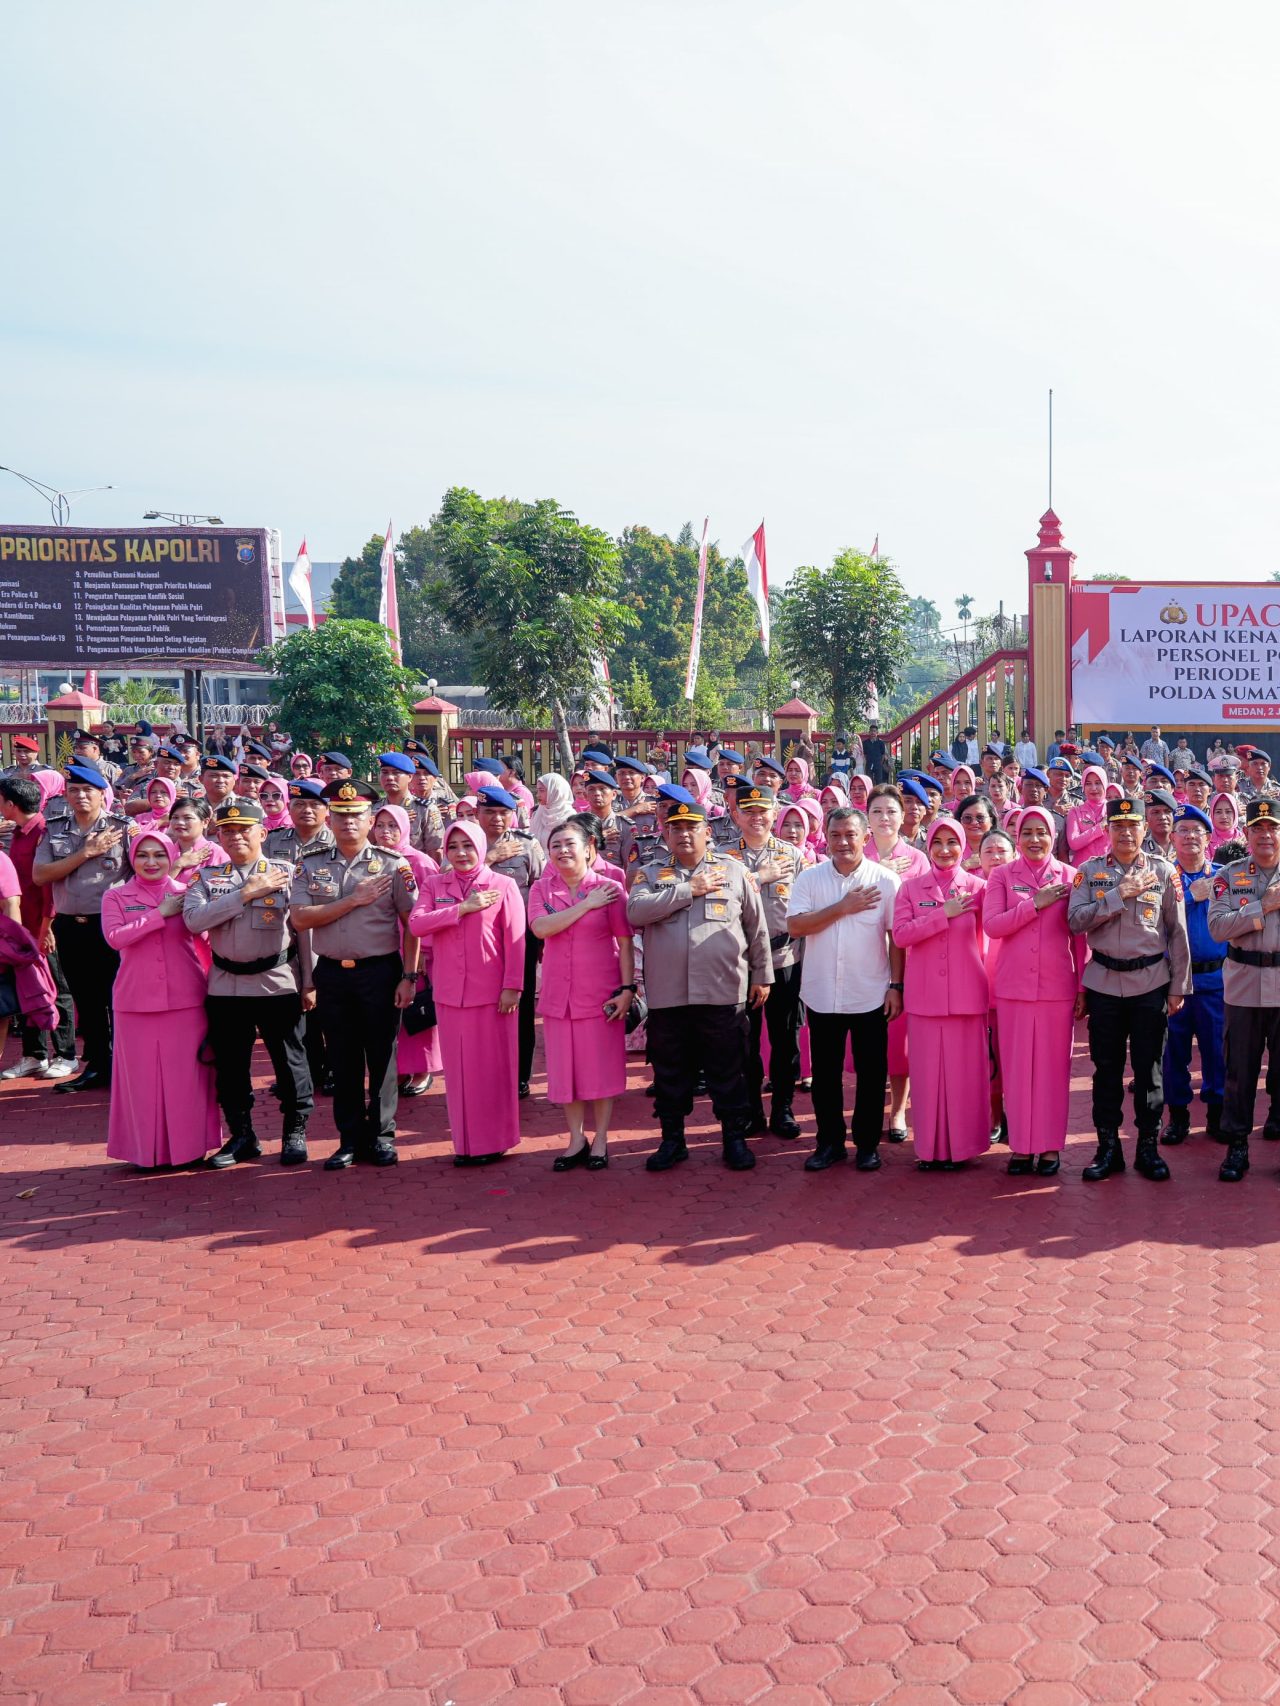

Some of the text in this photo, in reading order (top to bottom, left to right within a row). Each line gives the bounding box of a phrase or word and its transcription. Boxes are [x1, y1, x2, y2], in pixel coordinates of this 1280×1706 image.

[0, 536, 220, 563] PRIORITAS KAPOLRI
[136, 571, 160, 579] Nasional
[73, 581, 82, 589] 10.
[84, 582, 111, 590] Menjamin
[140, 582, 163, 590] Program
[188, 582, 212, 590] Nasional
[29, 591, 39, 599] 4.0
[73, 592, 82, 600] 11.
[84, 592, 114, 601] Penguatan
[114, 593, 147, 601] Penanganan
[85, 603, 119, 611] Peningkatan
[142, 603, 170, 612] Pelayanan
[120, 614, 147, 623] Pelayanan
[180, 614, 194, 622] Yang
[195, 615, 227, 623] Terintegrasi
[7, 633, 40, 642] Penanganan
[41, 634, 66, 642] Covid-19
[86, 635, 119, 643] Pengawasan
[120, 635, 145, 643] Pimpinan
[1120, 628, 1216, 644] LAPORAN
[76, 645, 85, 653] 16.
[87, 646, 120, 654] Pengawasan
[133, 646, 165, 654] Masyarakat
[1157, 648, 1260, 663] PERSONEL
[1174, 667, 1261, 682] PERIODE
[1267, 665, 1273, 682] 1
[1149, 685, 1217, 700] POLDA
[1228, 707, 1267, 717] MEDAN,
[1267, 707, 1274, 716] 2
